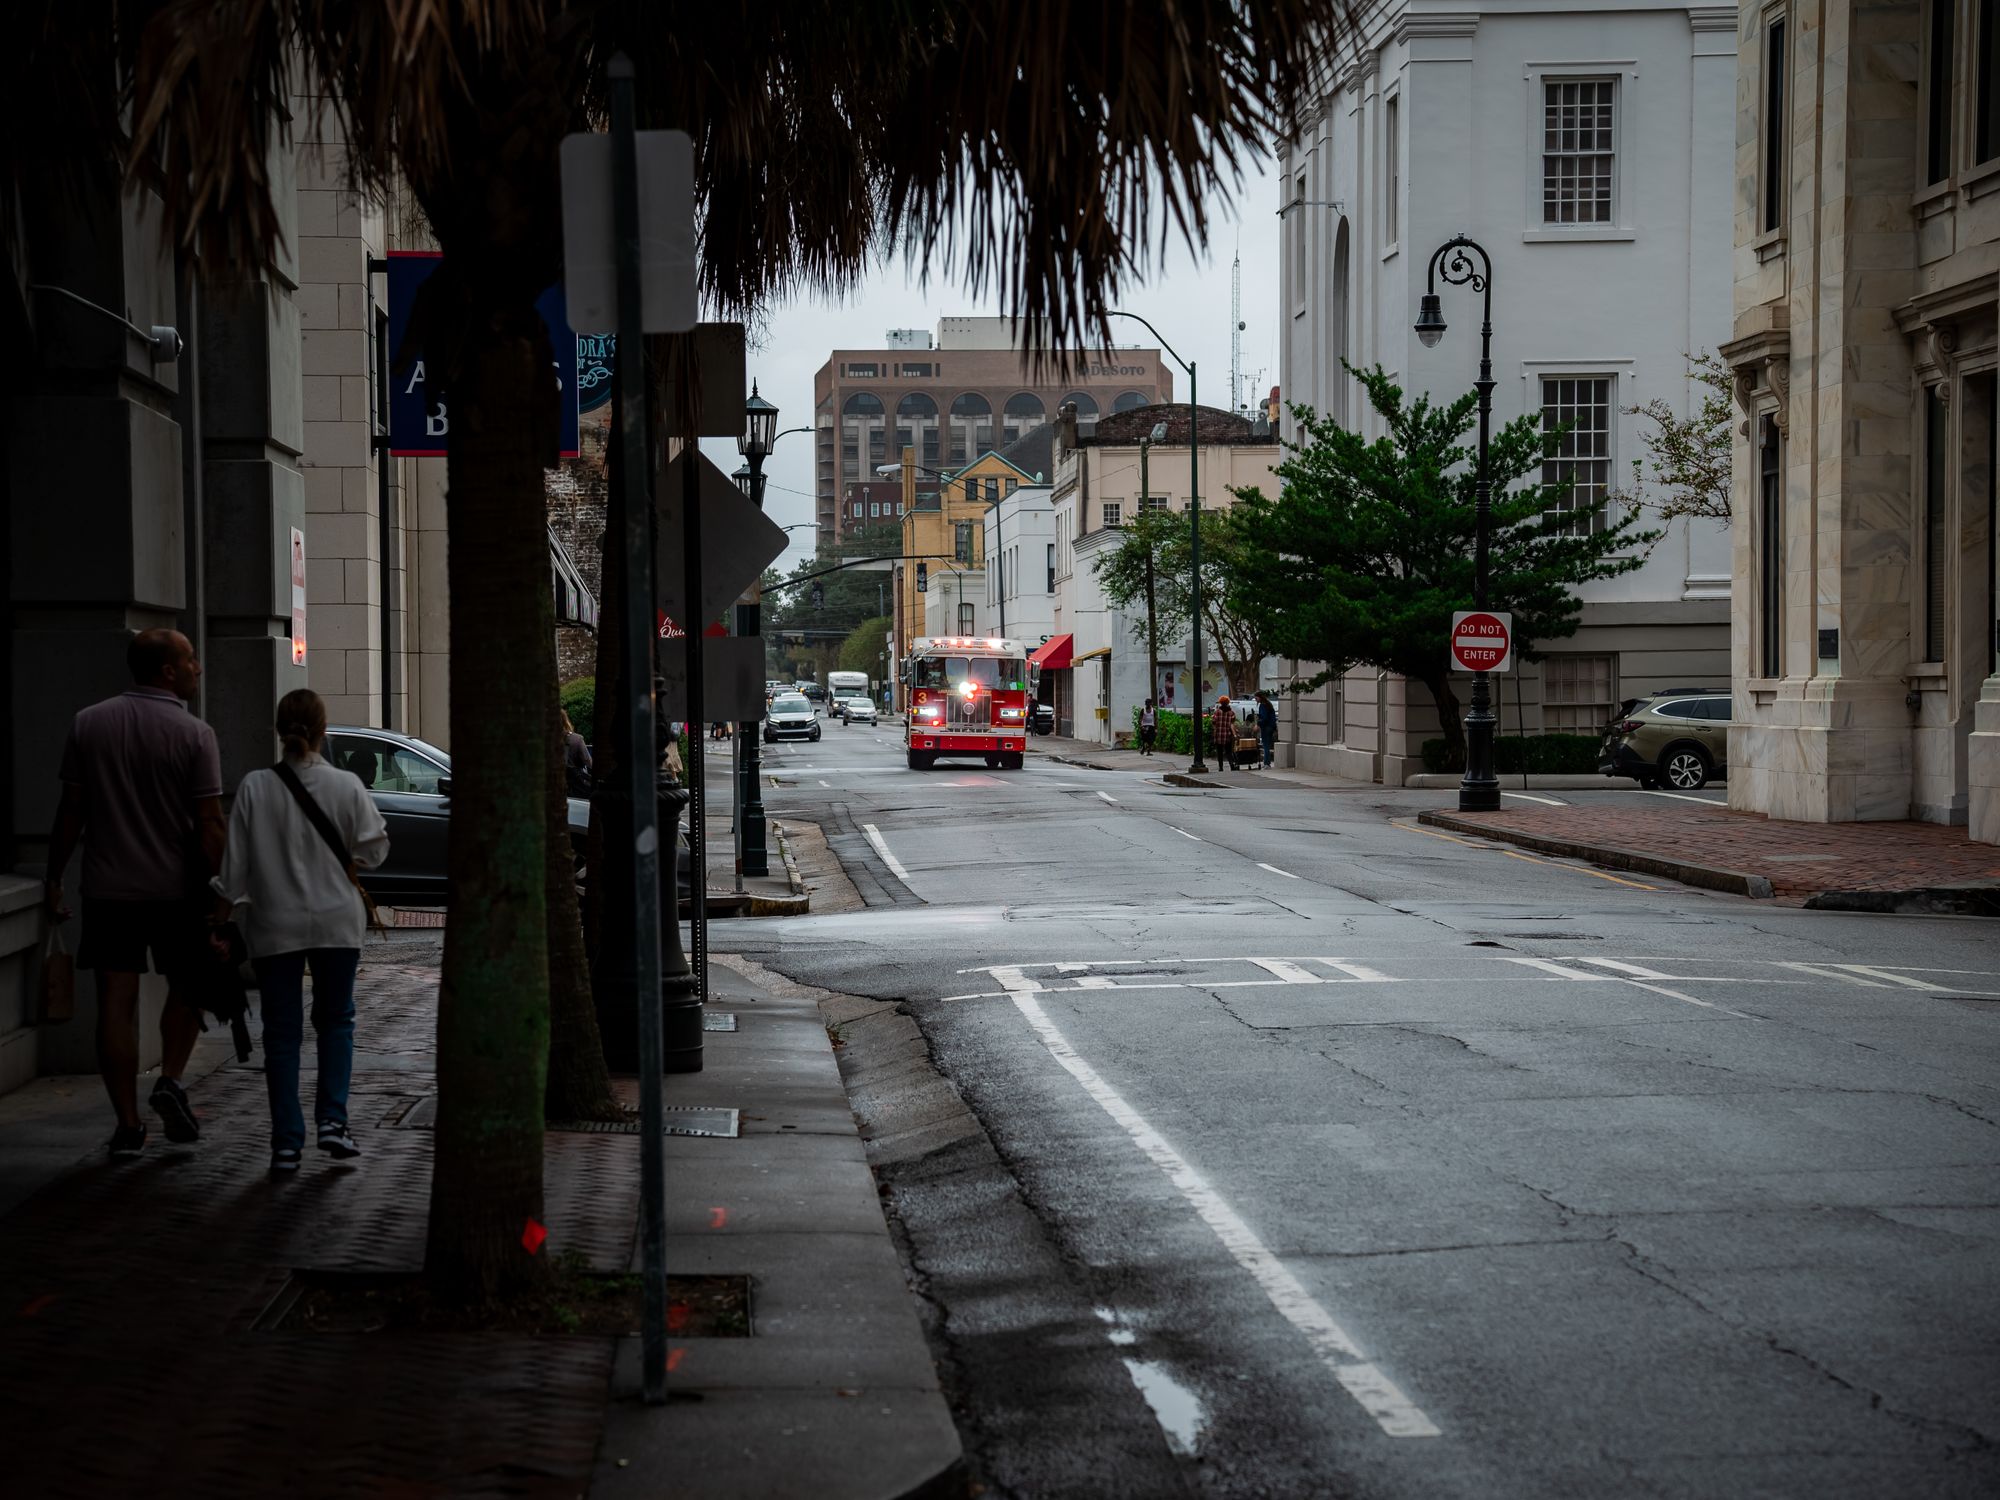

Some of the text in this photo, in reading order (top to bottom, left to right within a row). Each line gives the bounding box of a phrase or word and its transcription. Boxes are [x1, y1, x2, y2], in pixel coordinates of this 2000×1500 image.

[1461, 624, 1501, 635] DO NOT
[1463, 650, 1496, 660] ENTER
[918, 692, 928, 704] 3
